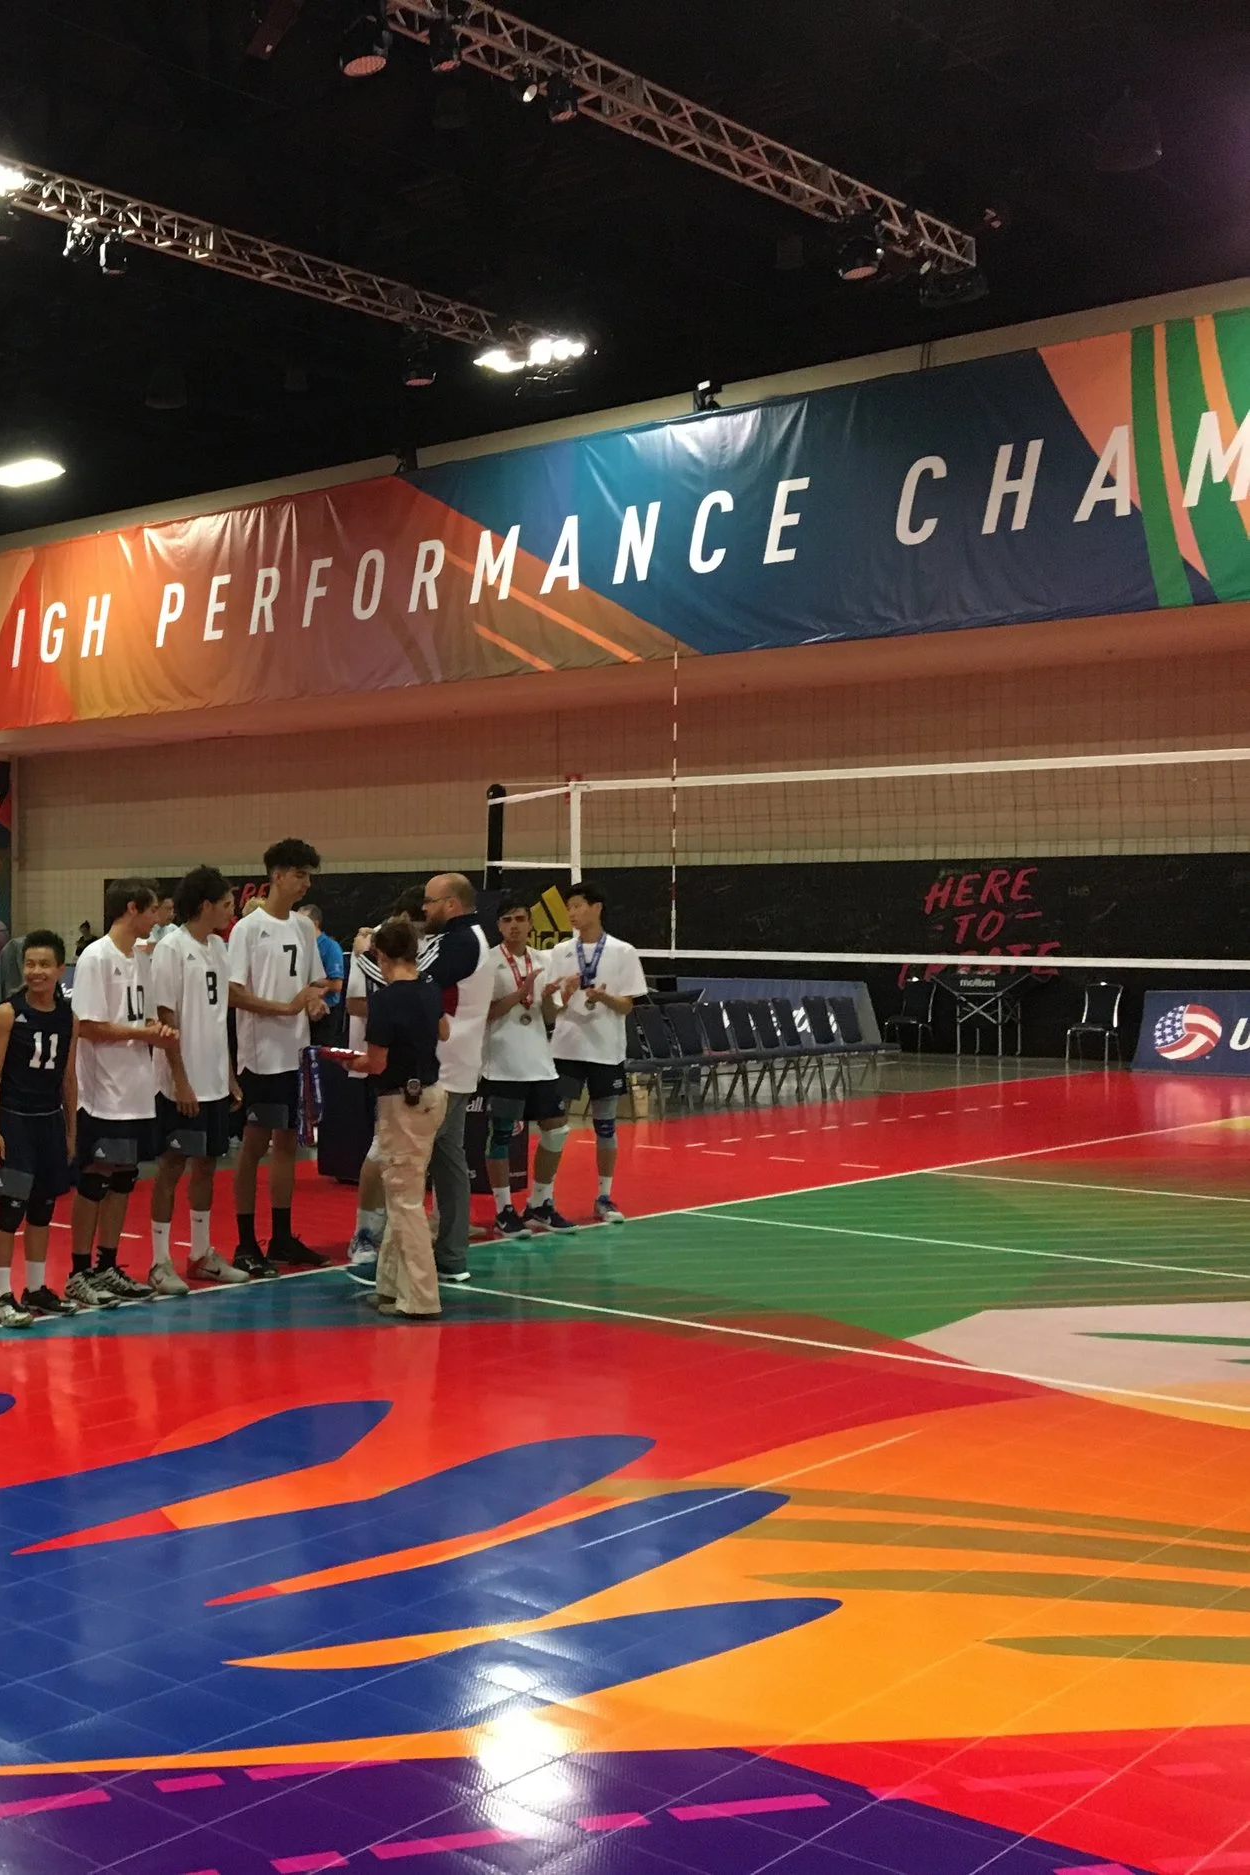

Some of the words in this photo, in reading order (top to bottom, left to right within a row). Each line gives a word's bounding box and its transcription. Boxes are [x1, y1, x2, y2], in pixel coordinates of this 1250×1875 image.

[155, 476, 810, 648] PERFORMANCE
[923, 867, 1038, 915] HERE
[283, 944, 297, 976] 7
[127, 985, 145, 1021] 10
[206, 971, 218, 1005] 8
[29, 1031, 59, 1069] 11
